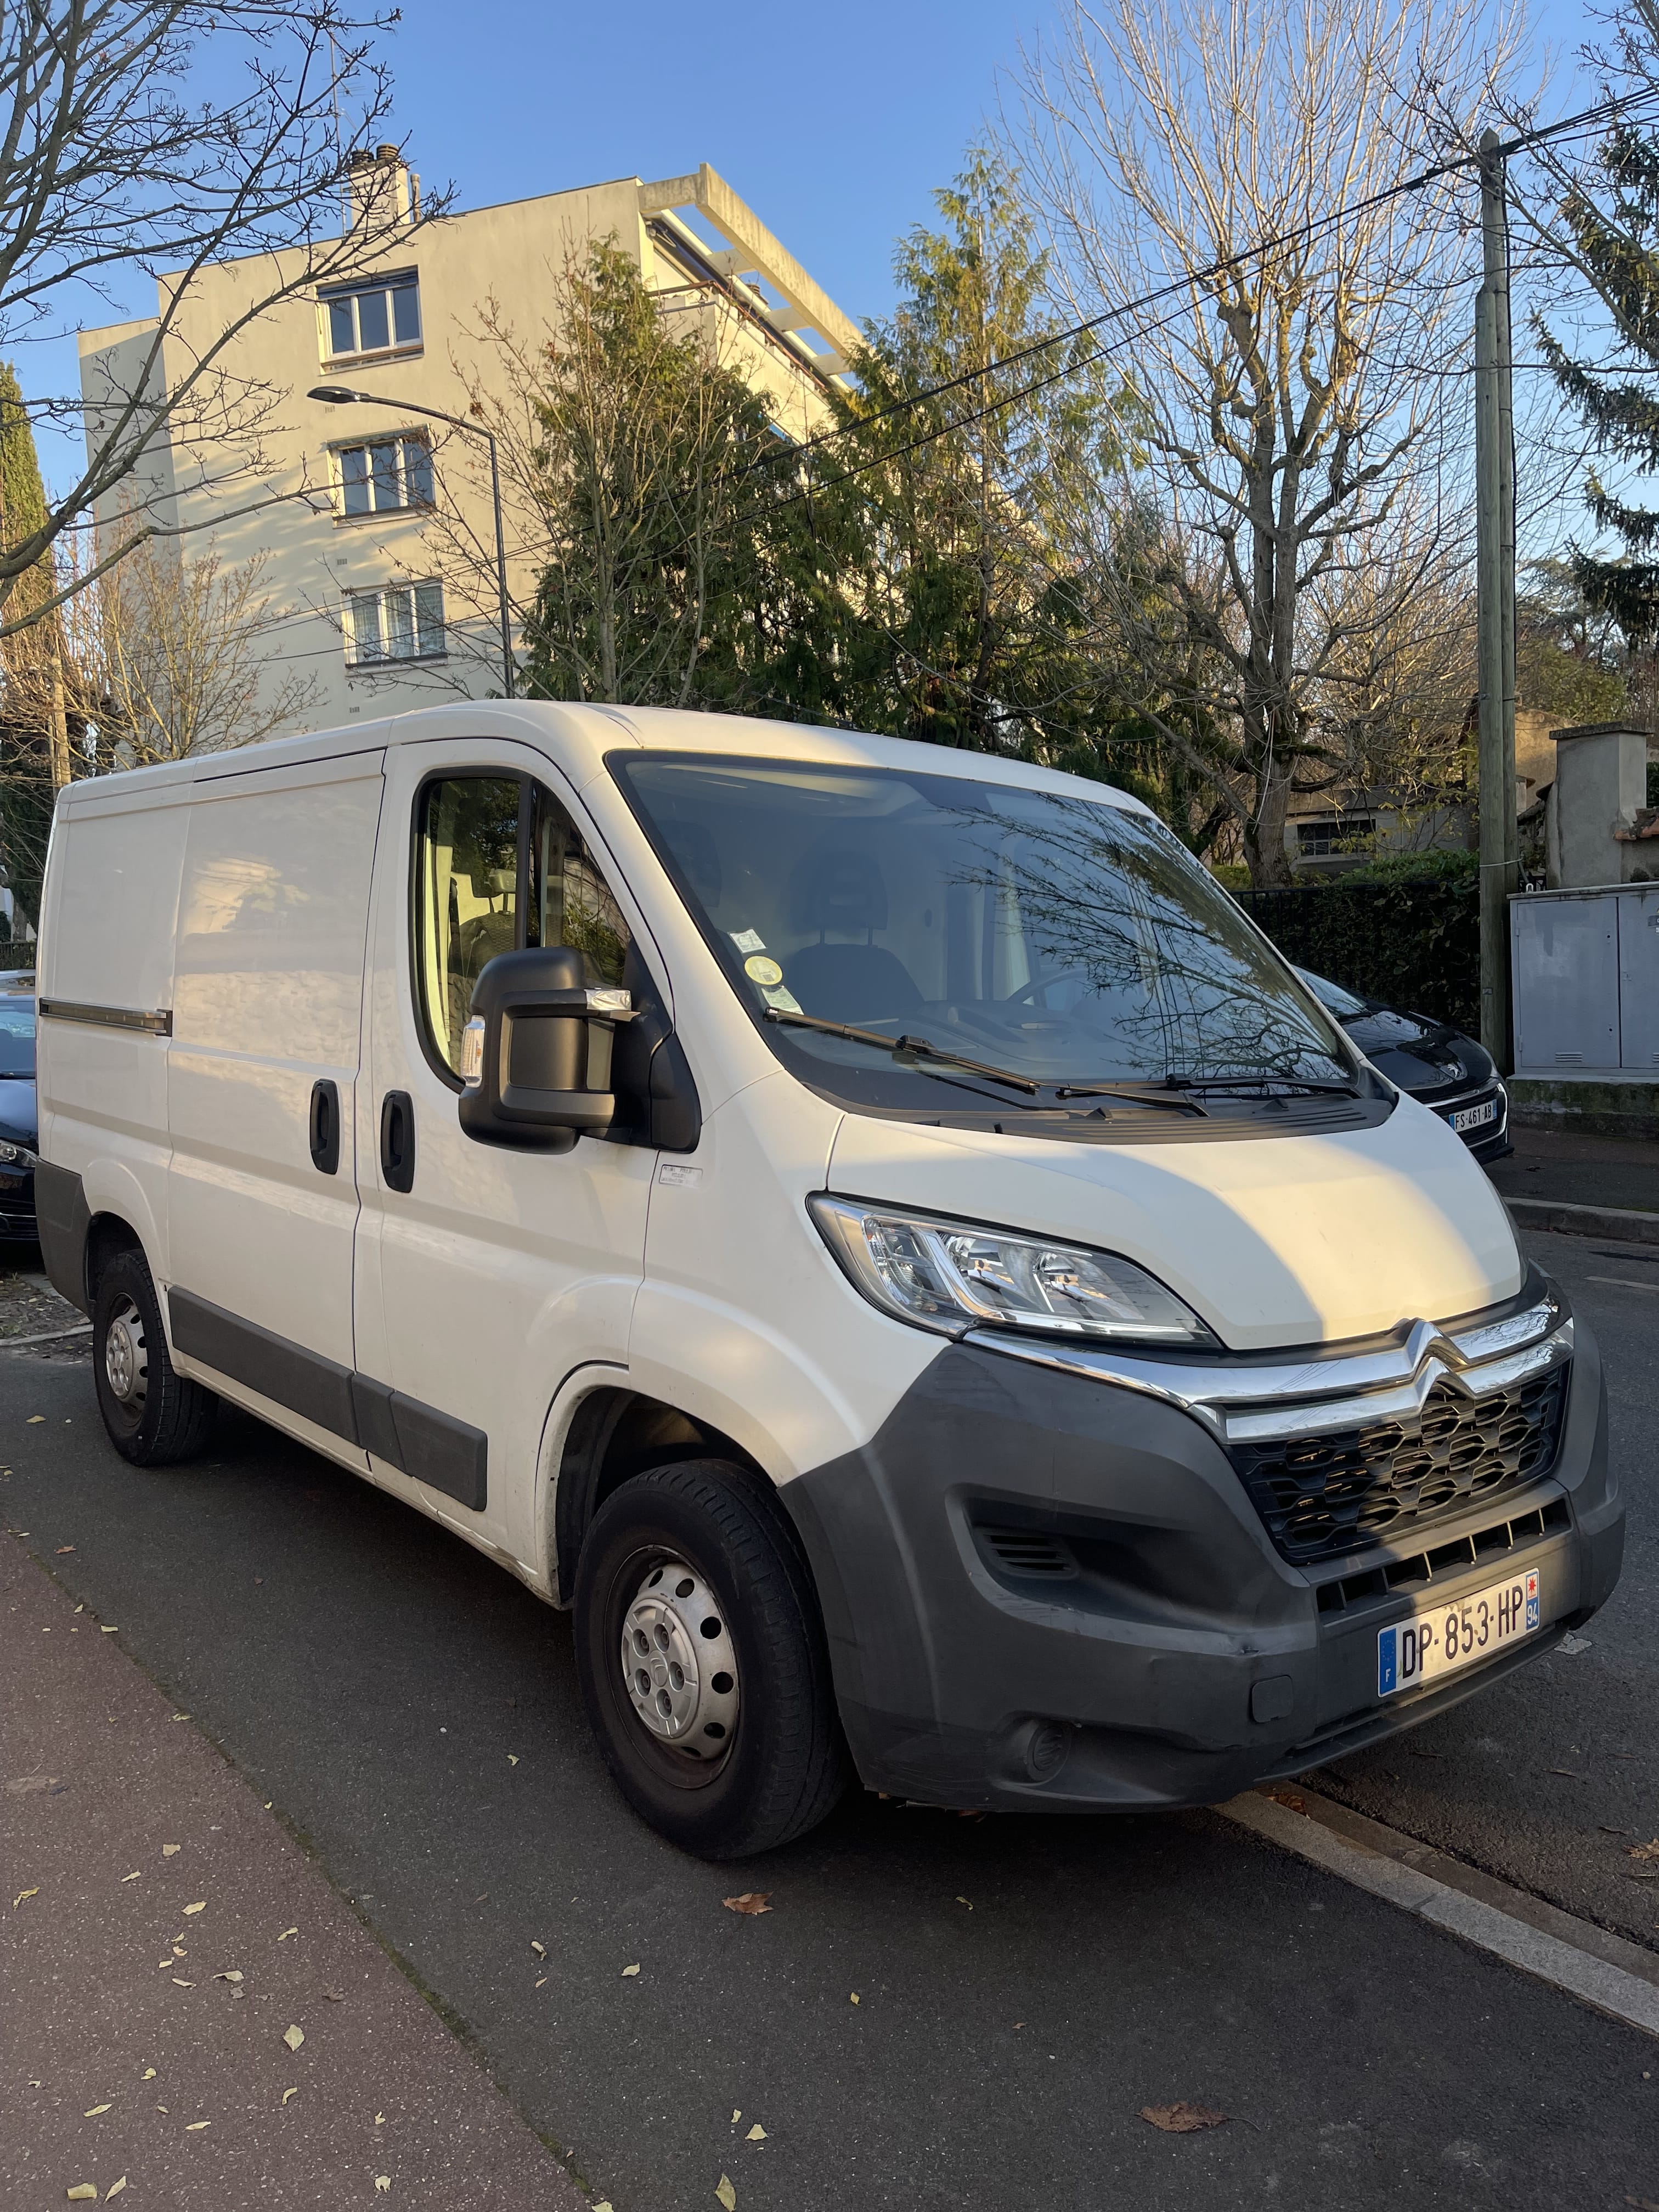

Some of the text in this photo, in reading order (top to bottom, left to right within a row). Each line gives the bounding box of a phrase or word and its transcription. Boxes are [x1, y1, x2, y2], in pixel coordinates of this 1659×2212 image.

[1455, 1104, 1492, 1130] FS-461-AB
[1385, 1585, 1538, 1683] F DP-853-HP 94
